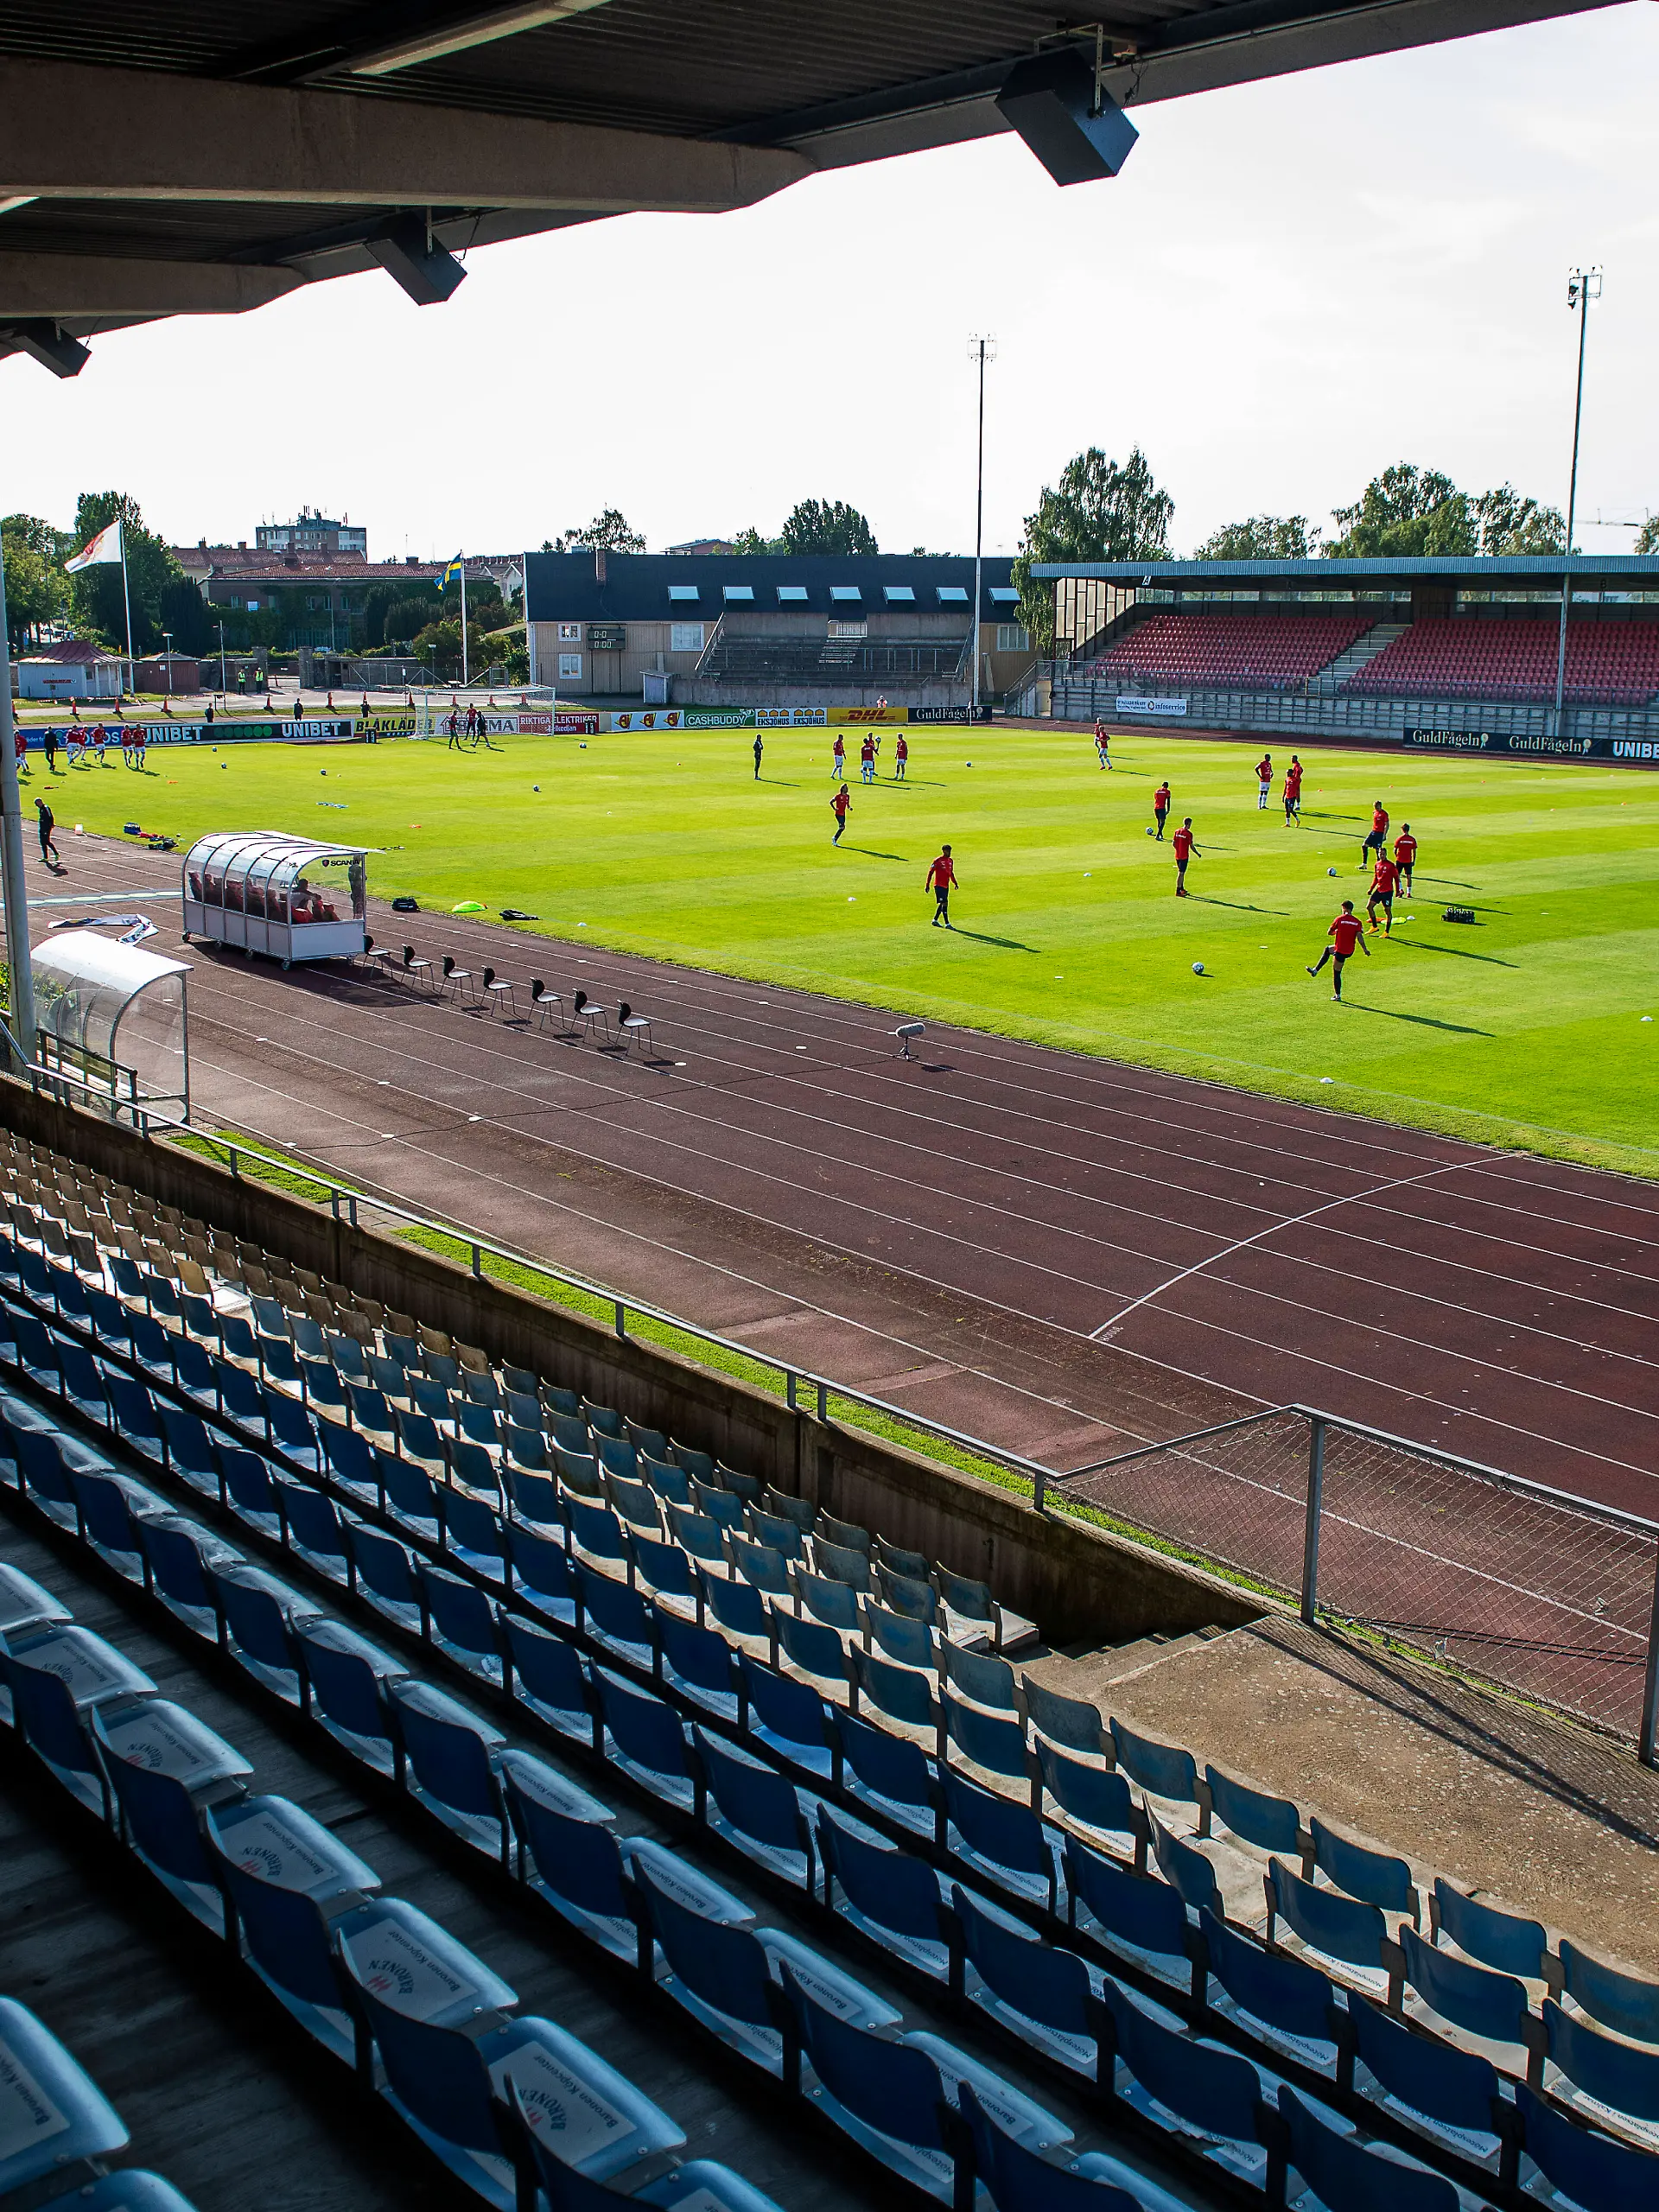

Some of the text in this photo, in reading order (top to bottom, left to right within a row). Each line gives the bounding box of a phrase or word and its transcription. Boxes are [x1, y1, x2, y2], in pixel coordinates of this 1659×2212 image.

[594, 630, 607, 639] 0-0
[520, 716, 551, 725] RIKTIGA
[688, 715, 745, 726] CASHBUDDY
[758, 716, 790, 726] EKSJÖHUS
[793, 715, 825, 725] EKSJÖHUS
[847, 709, 887, 721] DHL
[916, 708, 976, 721] GuldFågeln
[282, 722, 341, 738] UNIBET
[1413, 729, 1480, 748] GuldFågeln
[1509, 735, 1582, 754] GuldFågeln
[262, 1821, 325, 1875] Baronen Köpcenter
[242, 1847, 283, 1877] BARONEN
[676, 1885, 706, 1910] Baronen
[387, 1930, 461, 1993] Baronen Köpcenter
[368, 1960, 414, 1994] BARONEN
[815, 1983, 848, 2011] Baronen
[1039, 2024, 1091, 2058] Mötesplatsen
[16, 2082, 52, 2126] Baronen
[533, 2055, 620, 2129] Baronen Köpcenter
[518, 2089, 567, 2131] BARONEN
[976, 2093, 1016, 2126] Baronen
[1430, 2118, 1489, 2153] Mötesplatsen
